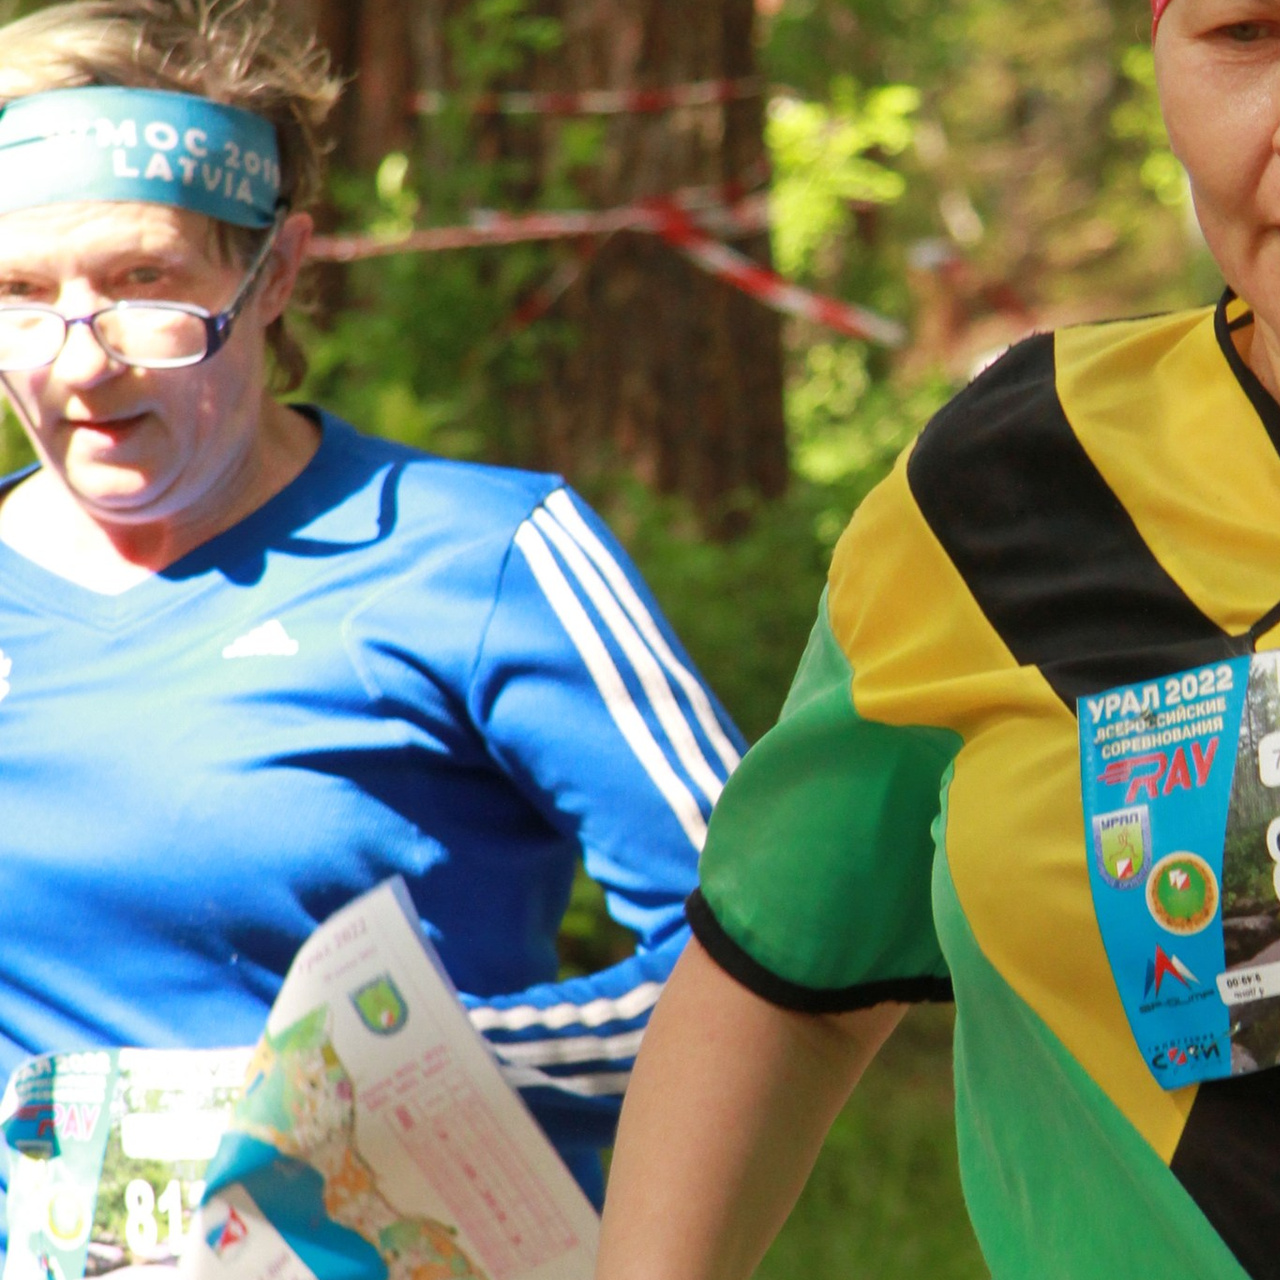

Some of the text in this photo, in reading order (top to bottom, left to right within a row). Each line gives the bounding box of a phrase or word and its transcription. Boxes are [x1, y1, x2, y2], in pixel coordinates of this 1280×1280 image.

[112, 148, 253, 204] LATVIA
[1087, 664, 1234, 724] УРАЛ 2022
[1101, 716, 1224, 760] СОРЕВНОВАНИЯ
[1097, 736, 1220, 804] RAY
